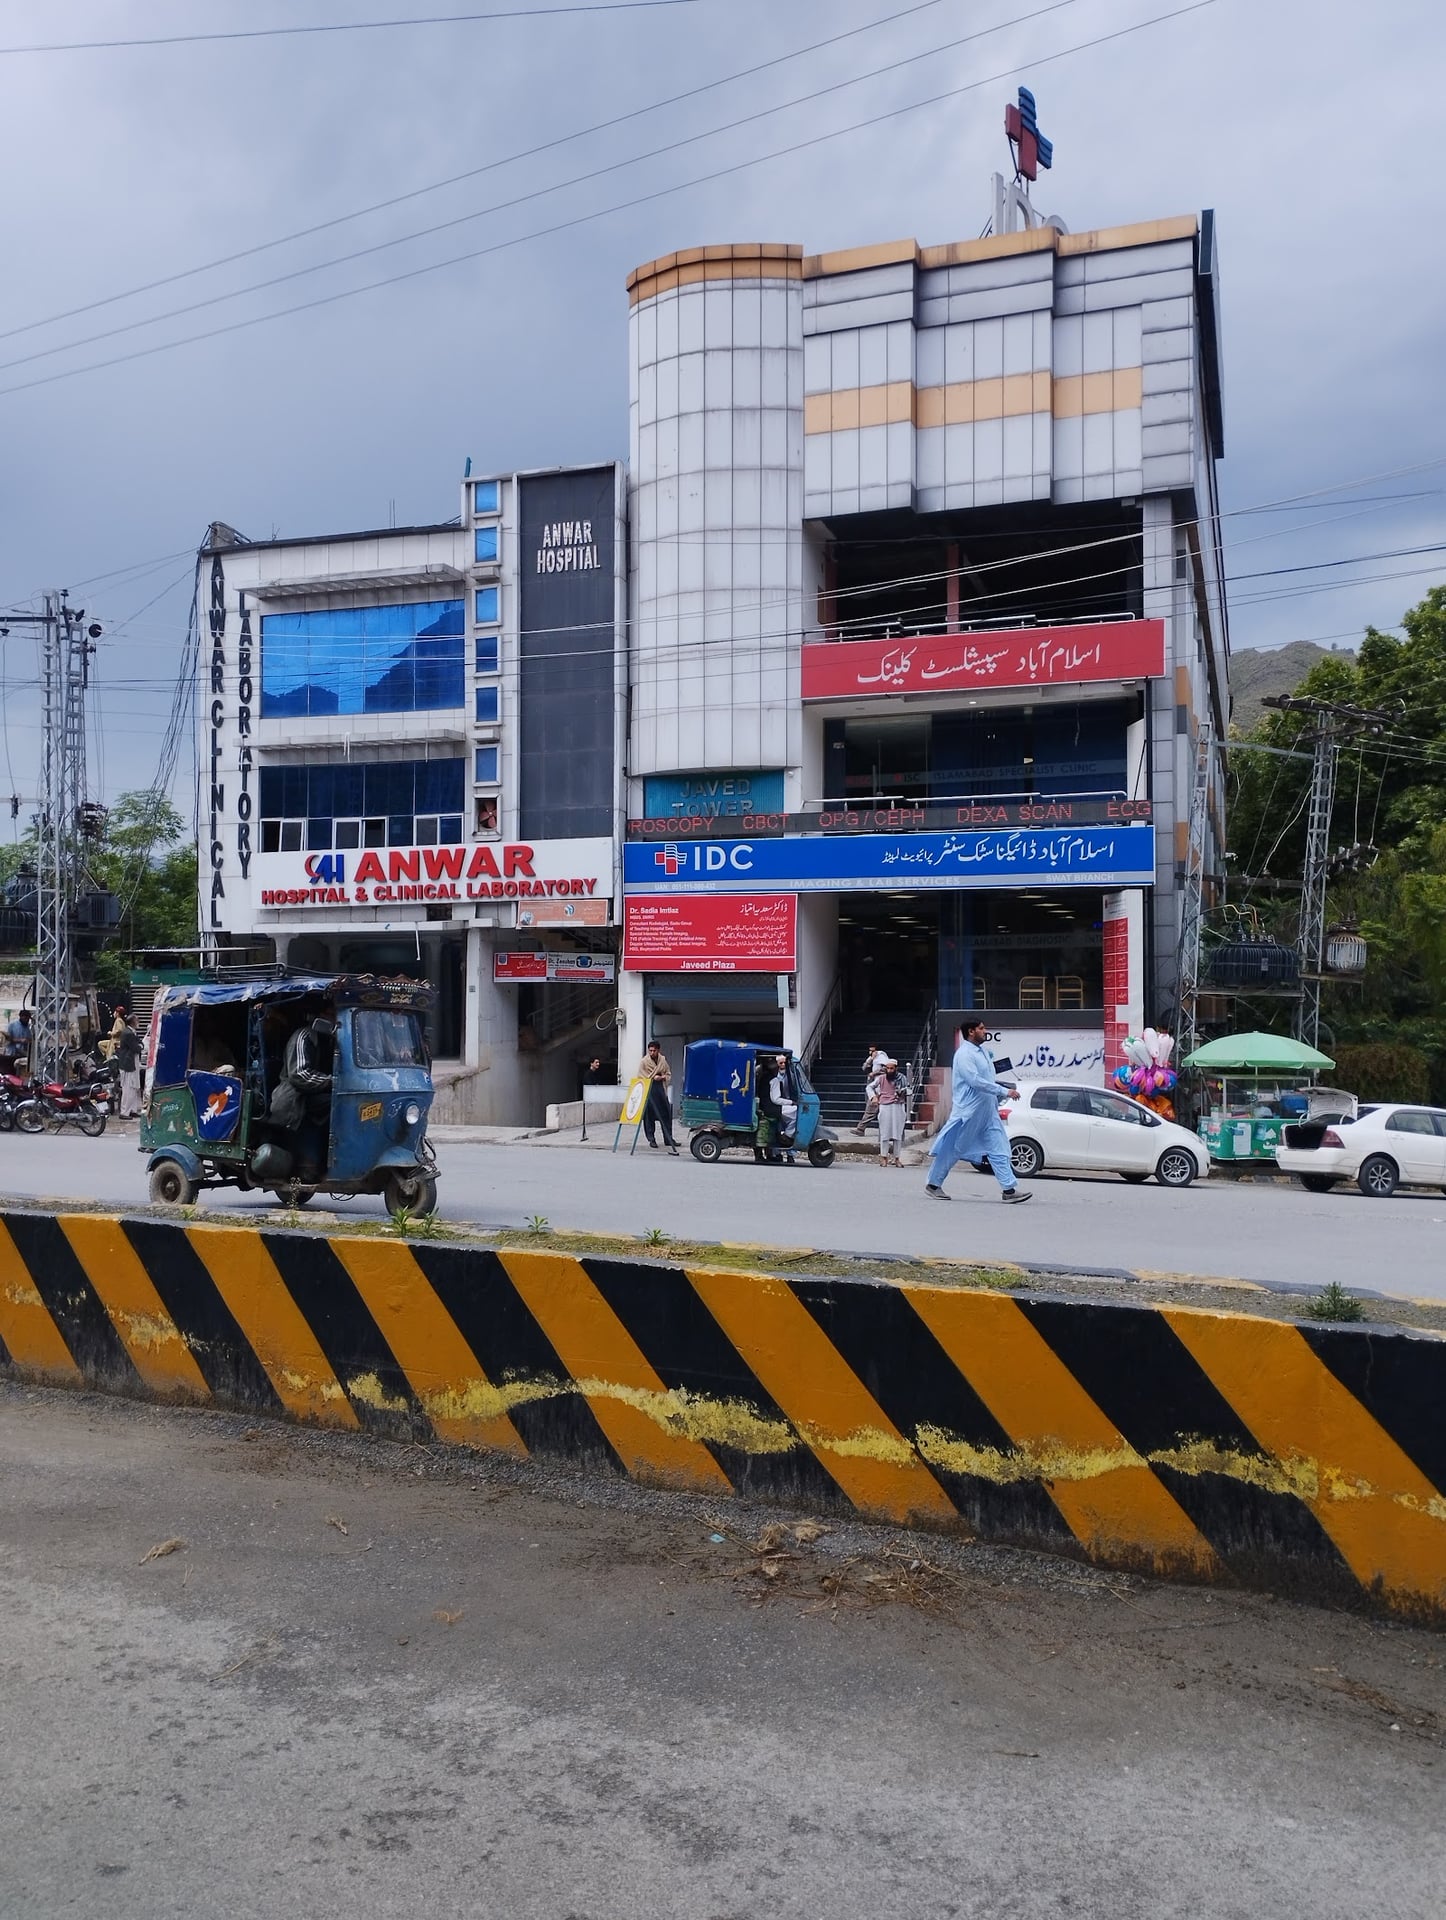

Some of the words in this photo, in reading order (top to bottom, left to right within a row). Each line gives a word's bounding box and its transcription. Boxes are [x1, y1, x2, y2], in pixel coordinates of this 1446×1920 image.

[542, 520, 593, 548] ANWAR
[536, 546, 601, 574] HOSPITAL
[209, 555, 226, 693] ANWAR
[857, 646, 918, 684] کلینک
[1016, 640, 1052, 678] آباد
[1050, 643, 1101, 677] اسلام
[237, 591, 254, 880] LABORATORY
[680, 778, 752, 797] JAVED
[209, 700, 225, 928] CLINICAL
[627, 815, 715, 835] ROSCOPY
[742, 813, 790, 831] CBCT
[819, 810, 859, 828] OPG
[874, 808, 925, 827] CEPH
[956, 805, 1008, 824] DEXA
[1018, 803, 1073, 821] SCAN
[1106, 801, 1152, 817] ECG
[671, 799, 755, 818] TOWER
[354, 844, 536, 883] ANWAR
[693, 844, 754, 872] IDC
[1039, 835, 1070, 866] آباد
[1068, 837, 1114, 864] اسلام
[261, 886, 350, 905] HOSPITAL
[355, 887, 369, 902] &
[373, 882, 461, 901] CLINICAL
[466, 877, 598, 896] LABORATORY
[790, 879, 853, 888] IMAGING
[868, 878, 893, 887] LAB
[896, 876, 961, 886] SERVICES
[1046, 874, 1071, 882] SWAT
[1073, 873, 1115, 882] BRANCH
[680, 960, 711, 969] Javeed
[712, 960, 736, 969] Plaza
[984, 1032, 1001, 1042] DC
